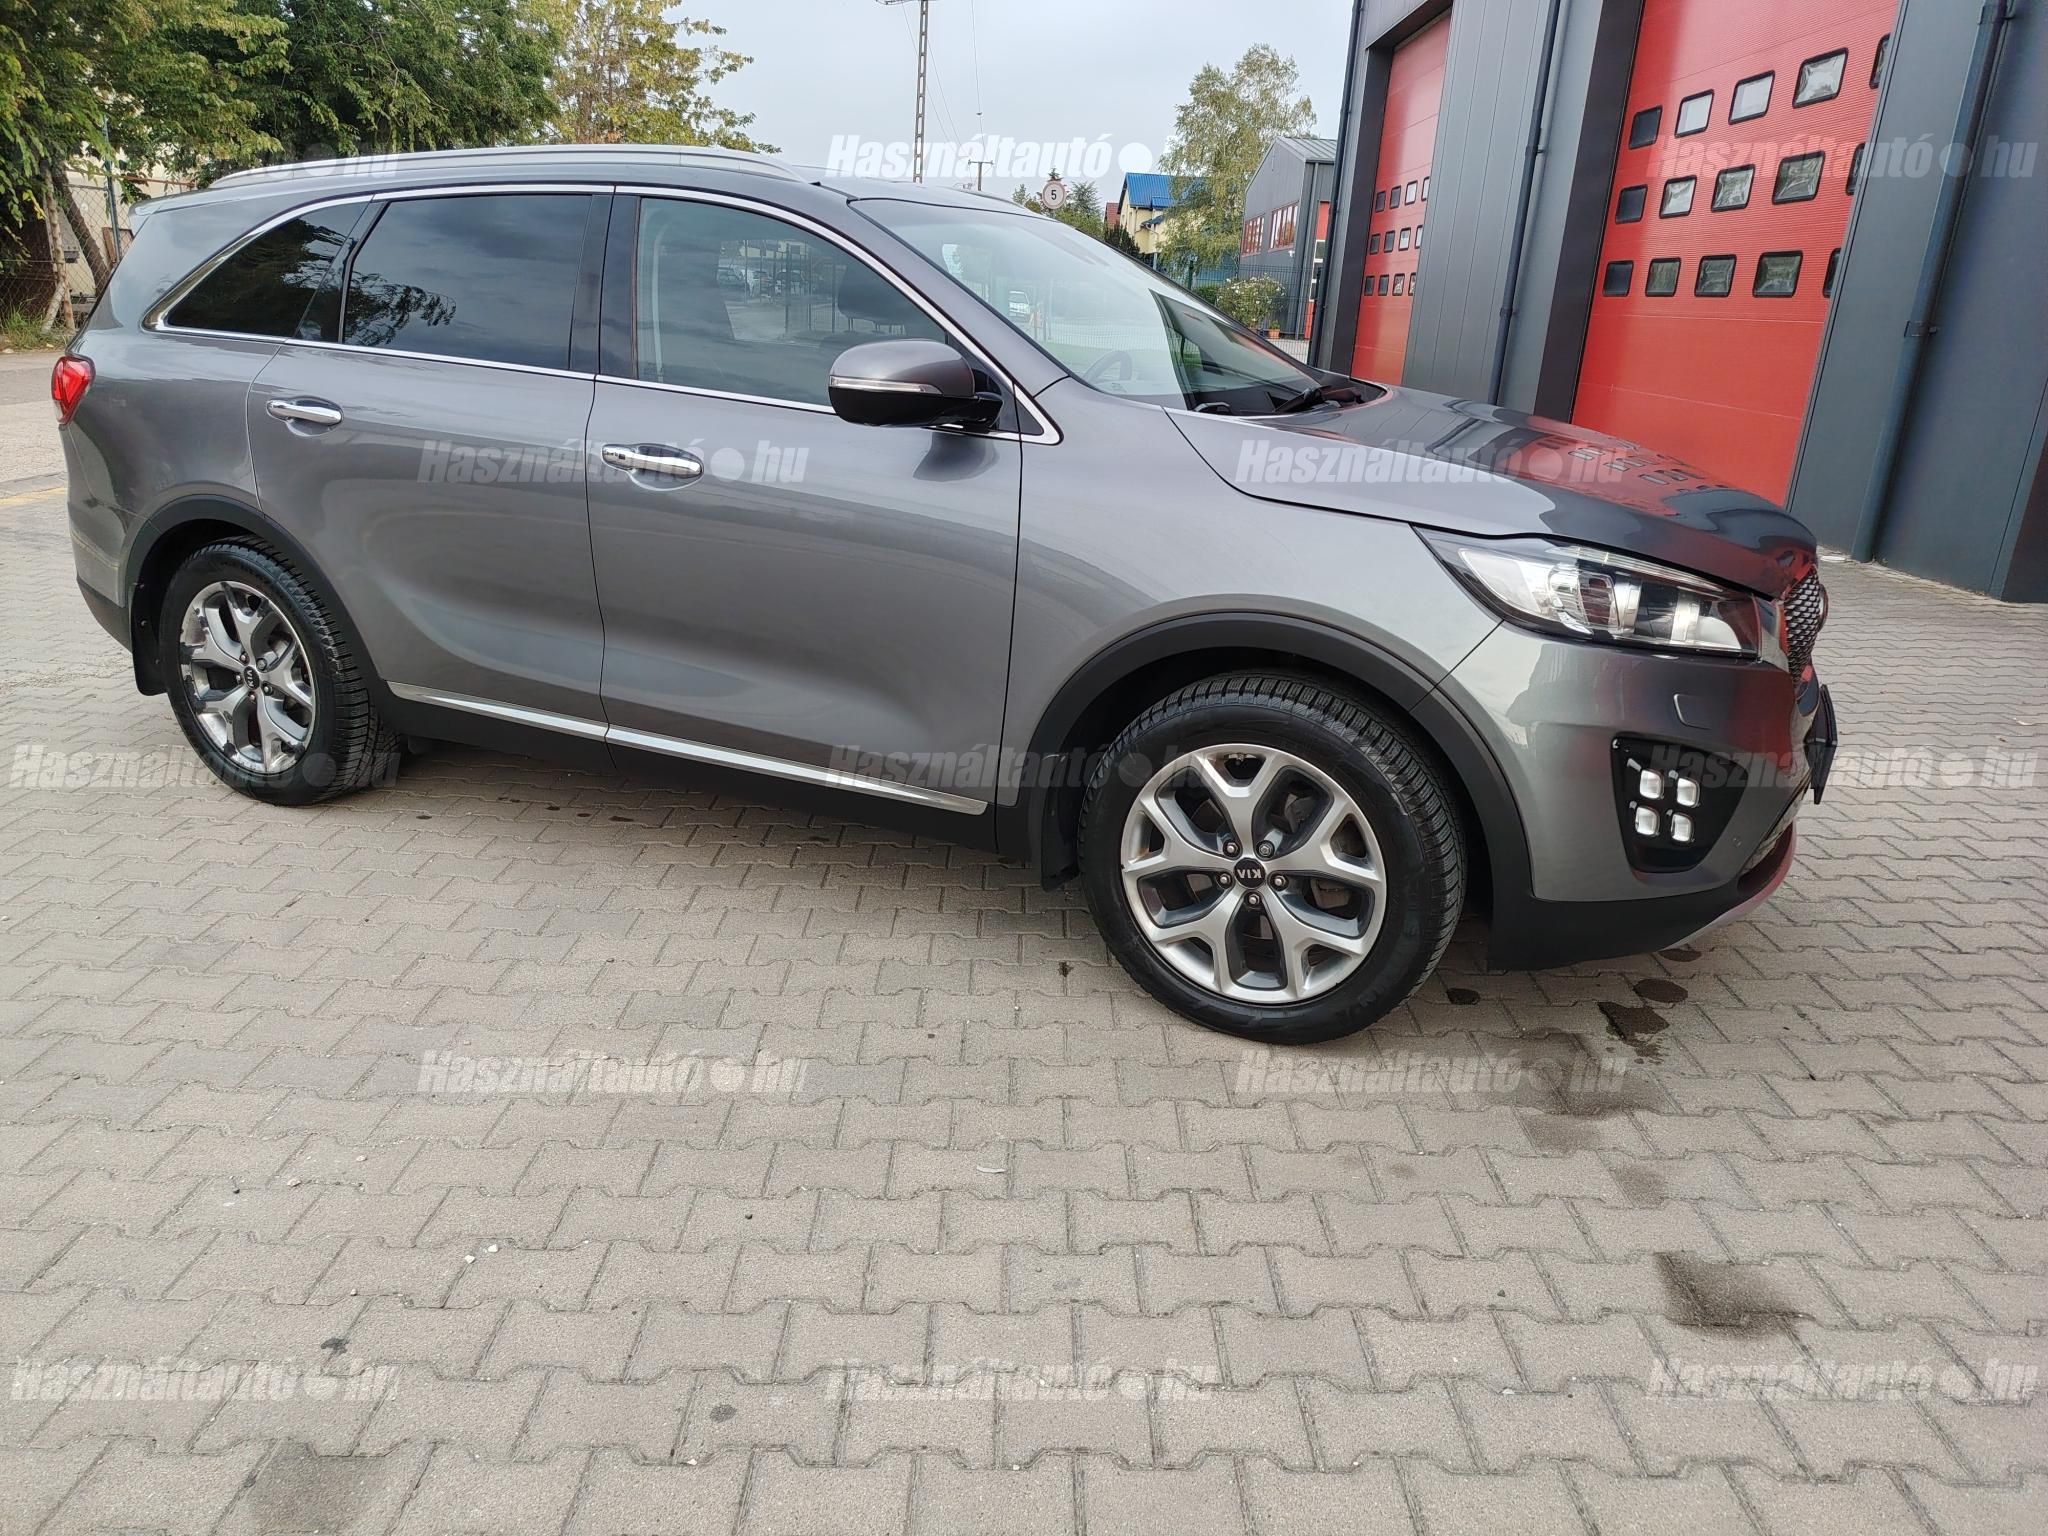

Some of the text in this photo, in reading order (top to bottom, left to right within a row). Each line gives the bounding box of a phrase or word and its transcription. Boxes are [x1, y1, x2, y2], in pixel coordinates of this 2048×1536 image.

[1051, 189, 1057, 201] 5
[246, 669, 255, 687] KIA
[1237, 868, 1262, 879] KIA
